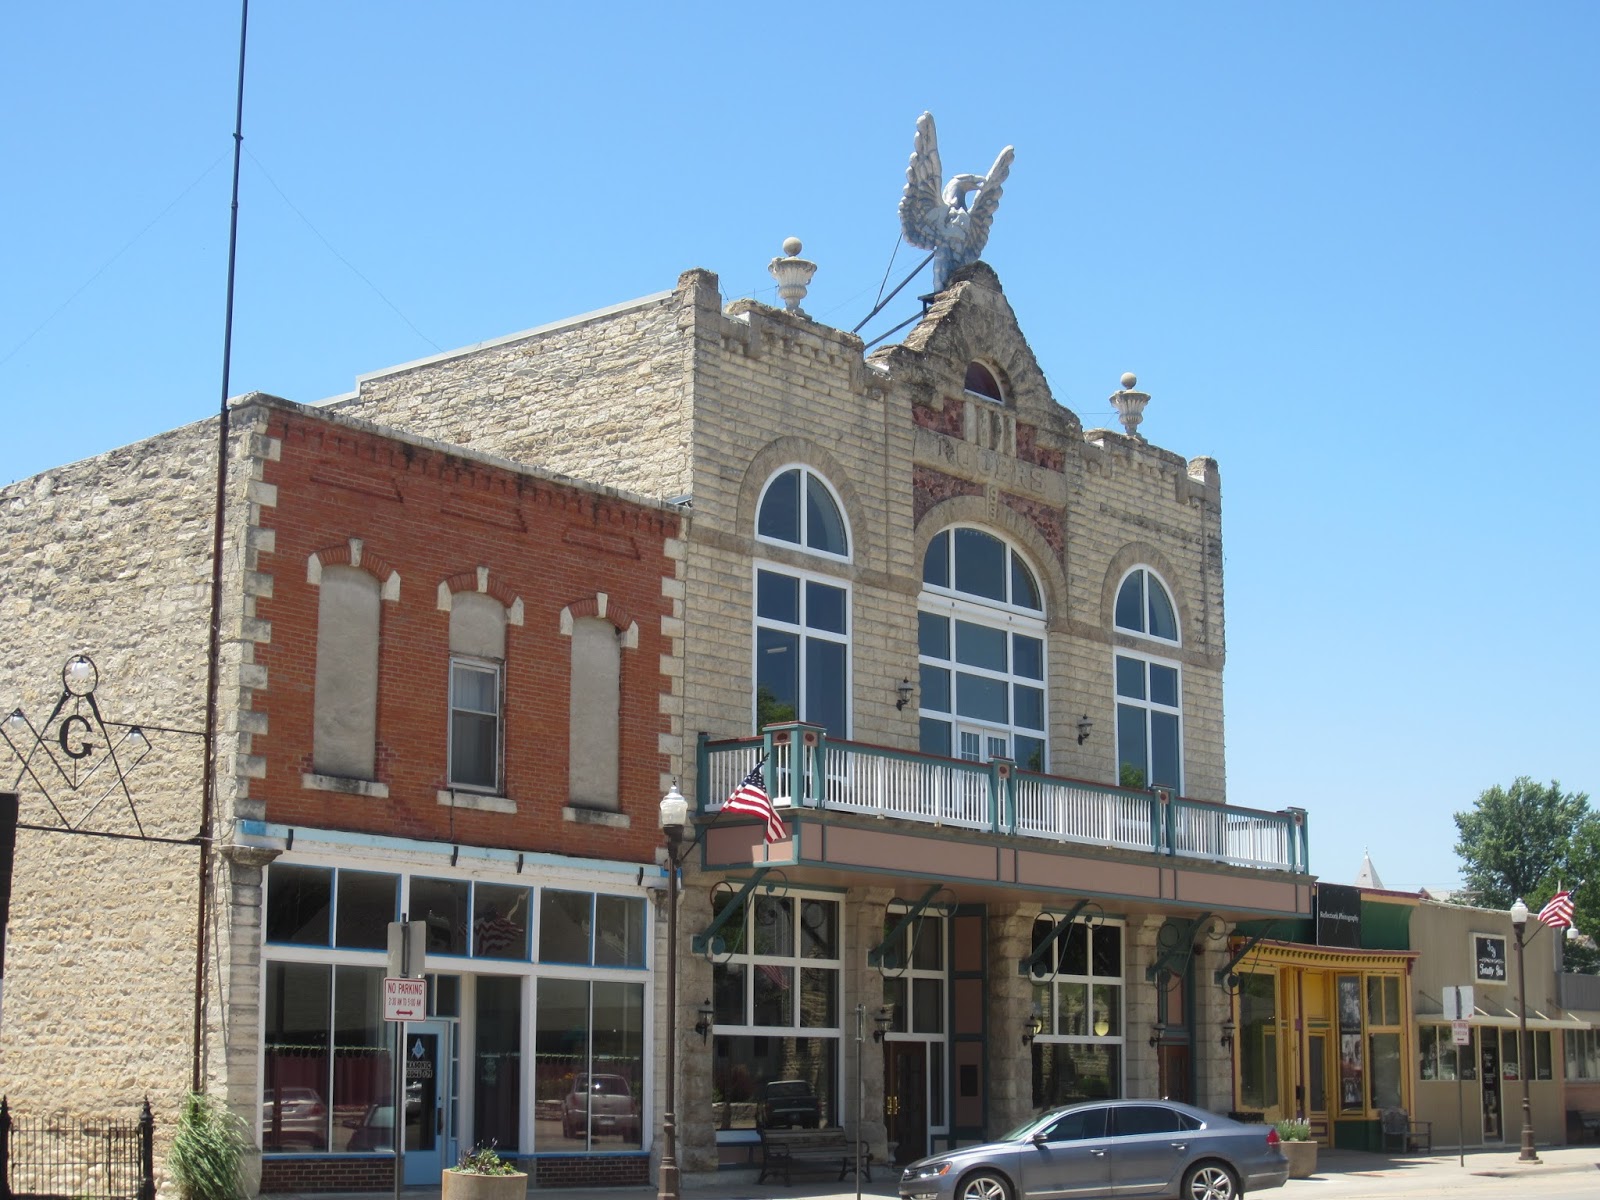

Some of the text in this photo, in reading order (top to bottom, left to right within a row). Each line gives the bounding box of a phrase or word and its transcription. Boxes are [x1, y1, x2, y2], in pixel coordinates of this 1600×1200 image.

[59, 714, 93, 759] G
[1339, 912, 1359, 923] Photography
[1479, 963, 1504, 977] Totally You
[388, 983, 423, 996] NO PARKING
[416, 999, 422, 1007] AM
